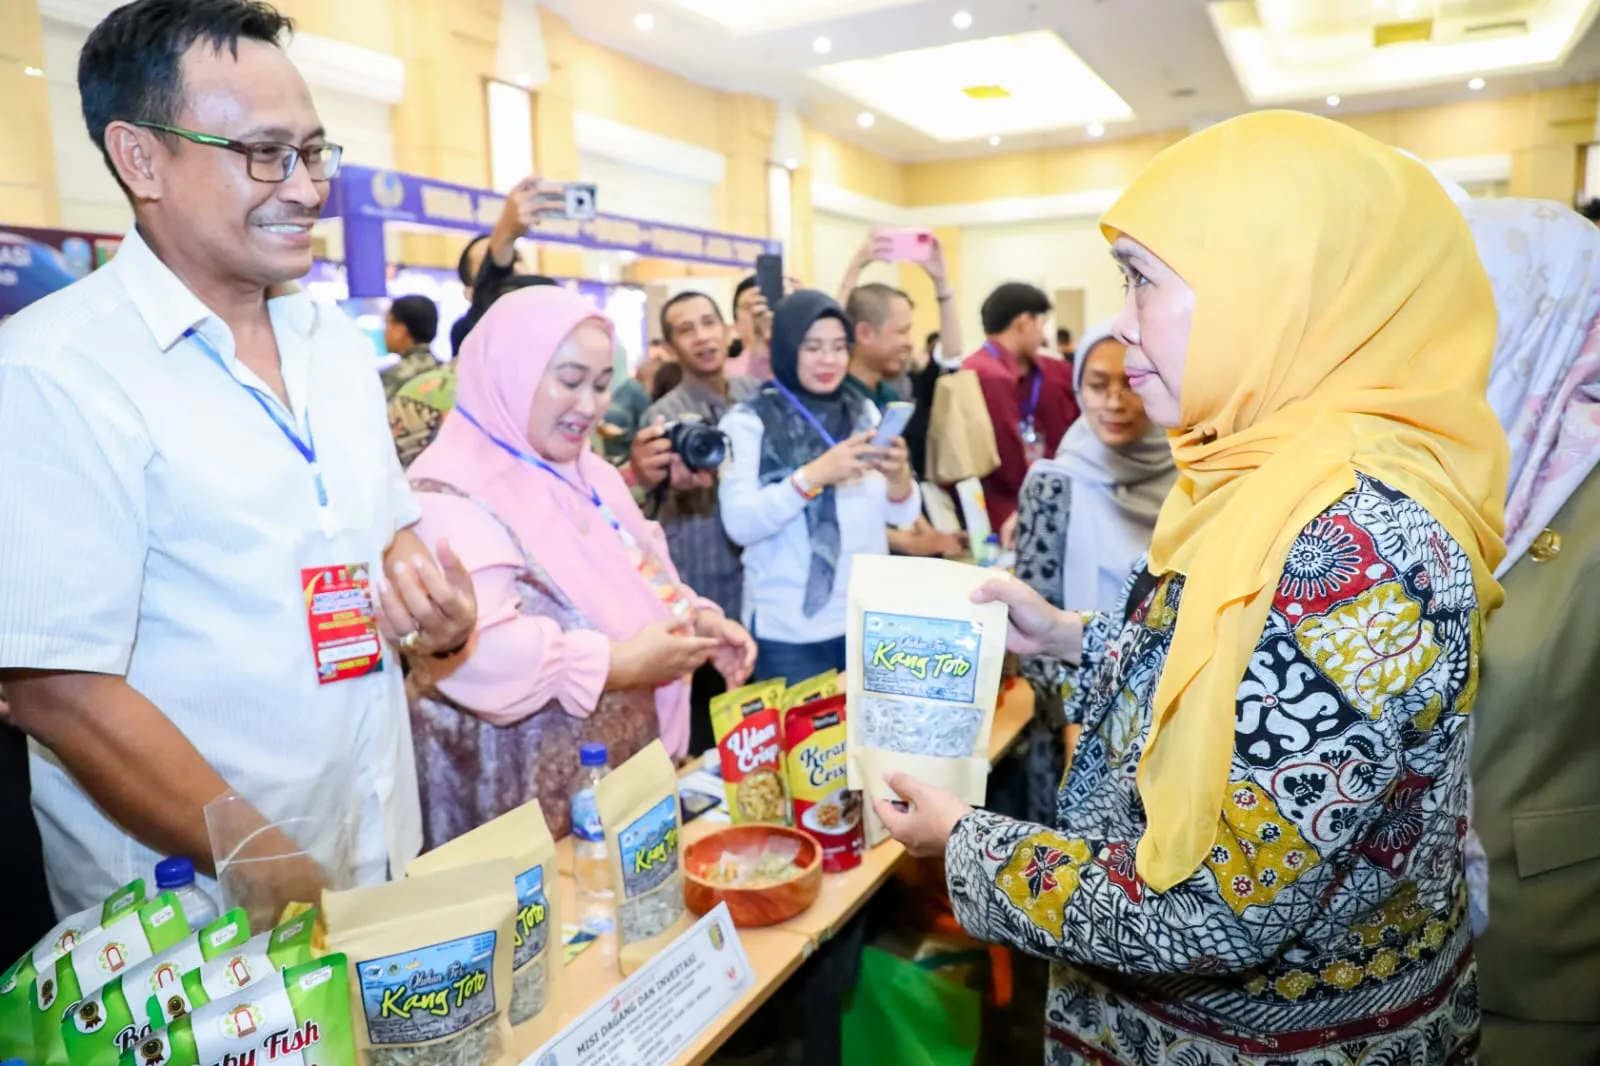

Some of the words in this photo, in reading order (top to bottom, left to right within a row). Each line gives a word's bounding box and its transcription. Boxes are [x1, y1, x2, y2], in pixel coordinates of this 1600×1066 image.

[872, 640, 930, 680] Kang
[932, 653, 972, 678] Toto
[634, 842, 668, 874] Kang
[517, 902, 545, 936] Toto
[380, 984, 450, 1020] Kang
[452, 970, 489, 1008] Toto
[576, 1032, 600, 1057] MISI
[600, 1001, 638, 1038] DAGANG
[637, 988, 656, 1007] DAN
[655, 952, 698, 992] INVESTASI
[263, 1020, 321, 1060] Fish
